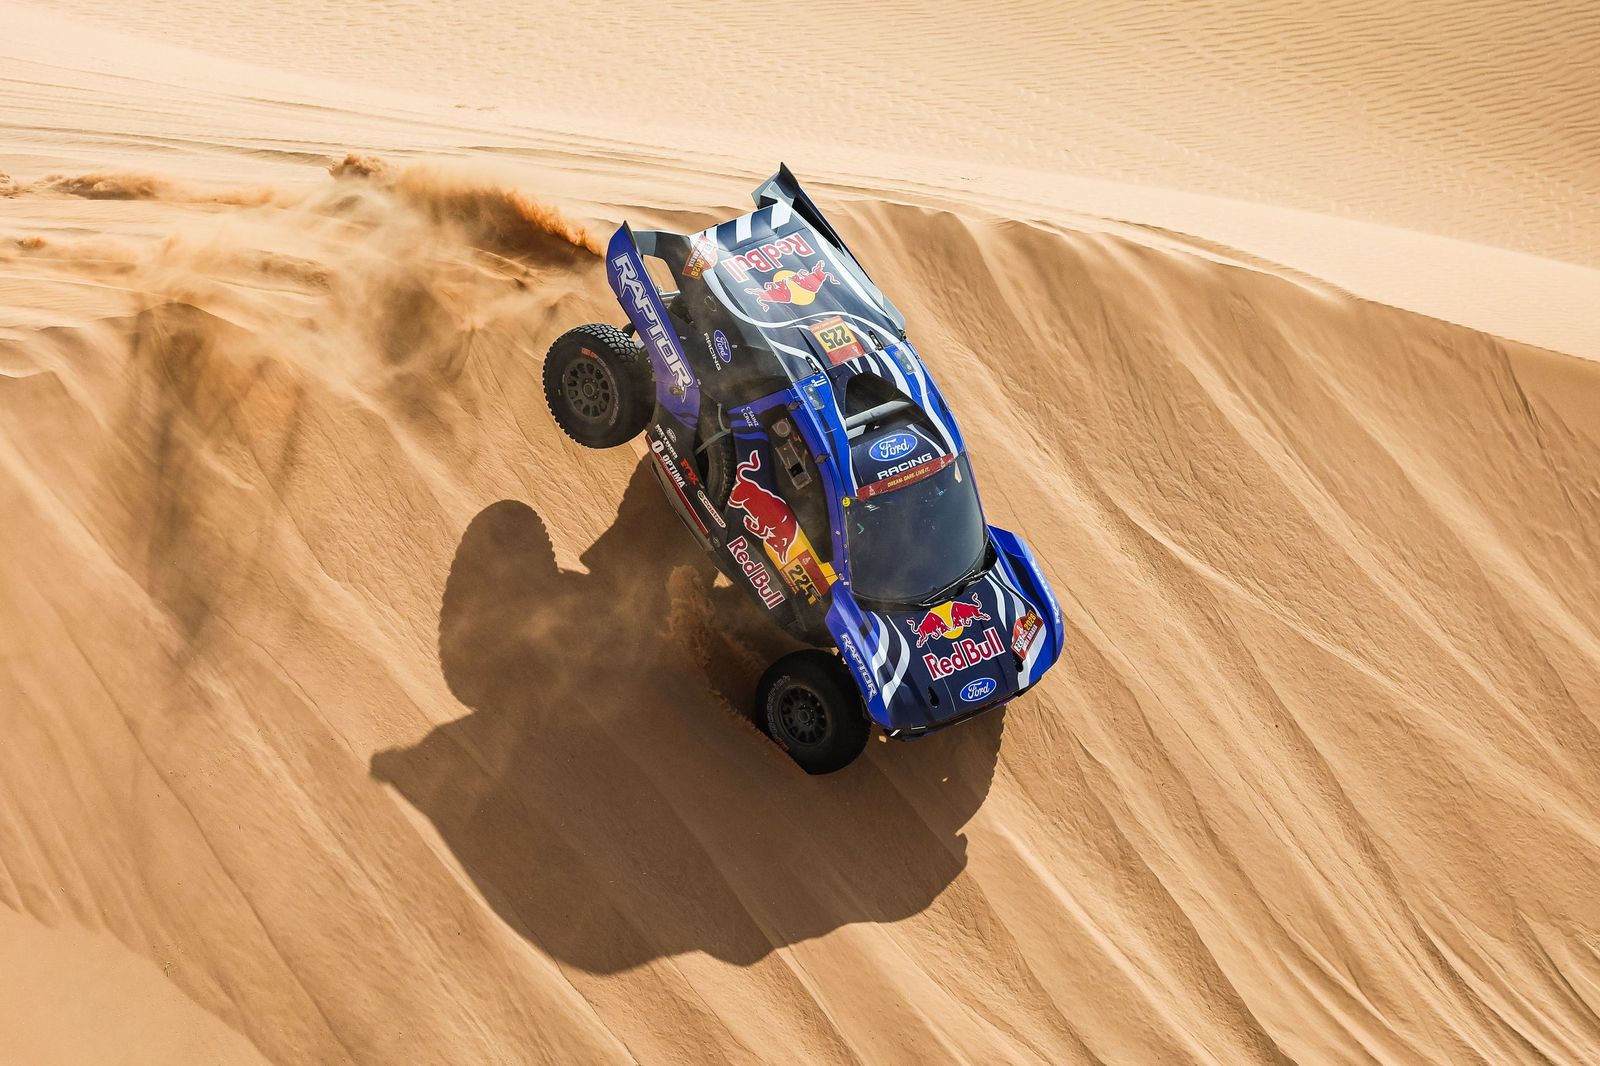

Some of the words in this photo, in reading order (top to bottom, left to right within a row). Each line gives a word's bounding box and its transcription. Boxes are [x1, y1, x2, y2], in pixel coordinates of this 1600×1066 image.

[611, 252, 693, 403] RAPTOR
[819, 325, 852, 350] 225
[703, 332, 722, 371] RACING
[878, 437, 910, 459] Ford
[662, 454, 686, 488] OPTIMA
[876, 452, 933, 480] RACING
[840, 632, 878, 703] RAPTOR
[966, 681, 991, 700] Ford
